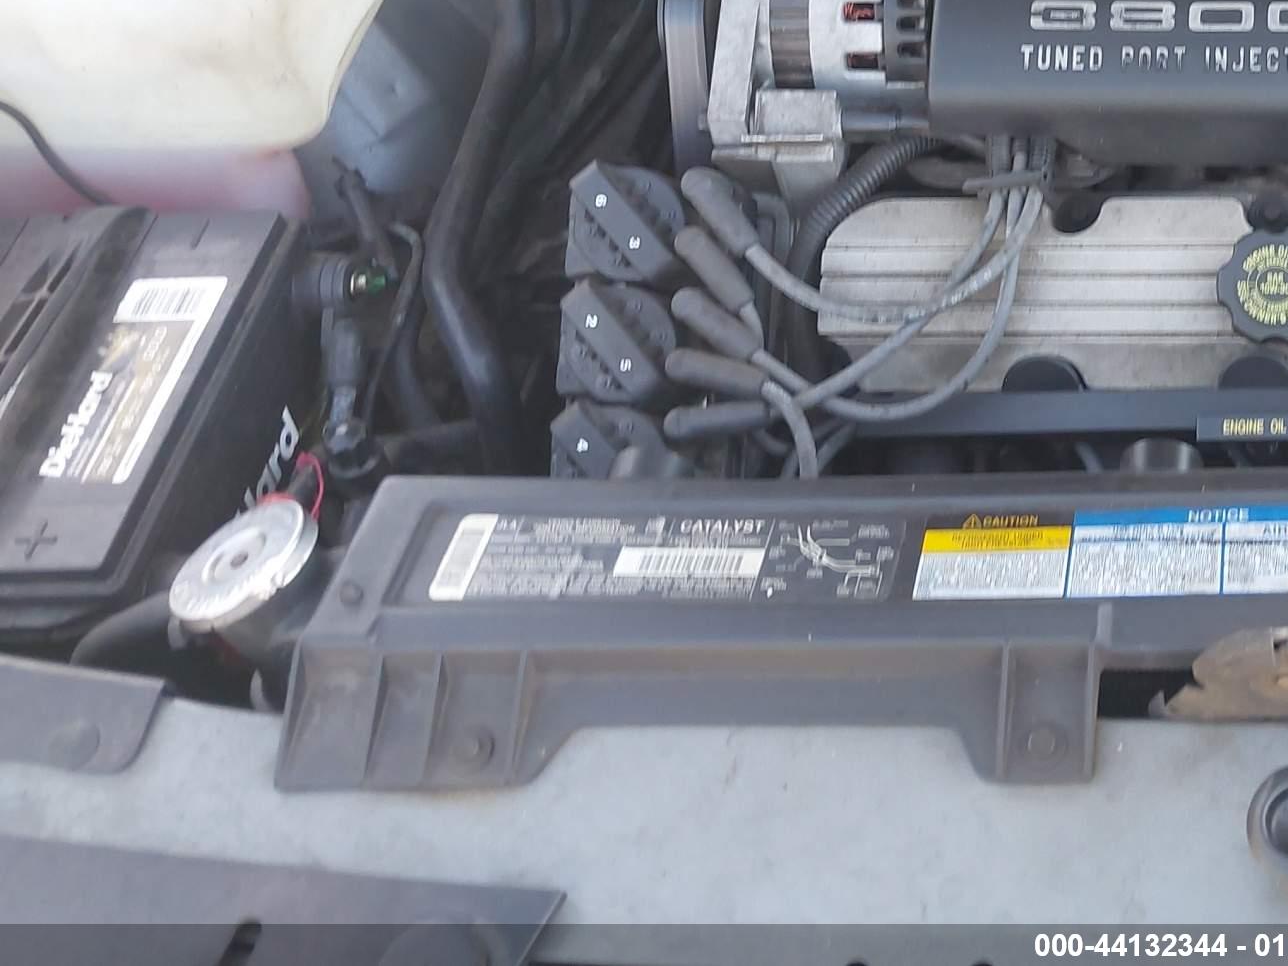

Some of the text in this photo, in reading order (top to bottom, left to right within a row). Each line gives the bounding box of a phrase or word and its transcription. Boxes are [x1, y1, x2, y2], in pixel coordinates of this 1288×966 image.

[1020, 43, 1104, 72] TUNED
[1121, 45, 1187, 71] PORT
[593, 193, 608, 208] 6
[628, 235, 641, 250] 3
[585, 313, 599, 329] 2
[619, 357, 633, 372] 5
[38, 370, 113, 478] DieHard
[1222, 417, 1288, 436] ENGINE OIL
[575, 438, 589, 453] 4
[982, 514, 1039, 528] CAUTION
[1187, 507, 1249, 524] NOTICE
[680, 518, 766, 534] CATALYST
[1263, 522, 1288, 535] AIR
